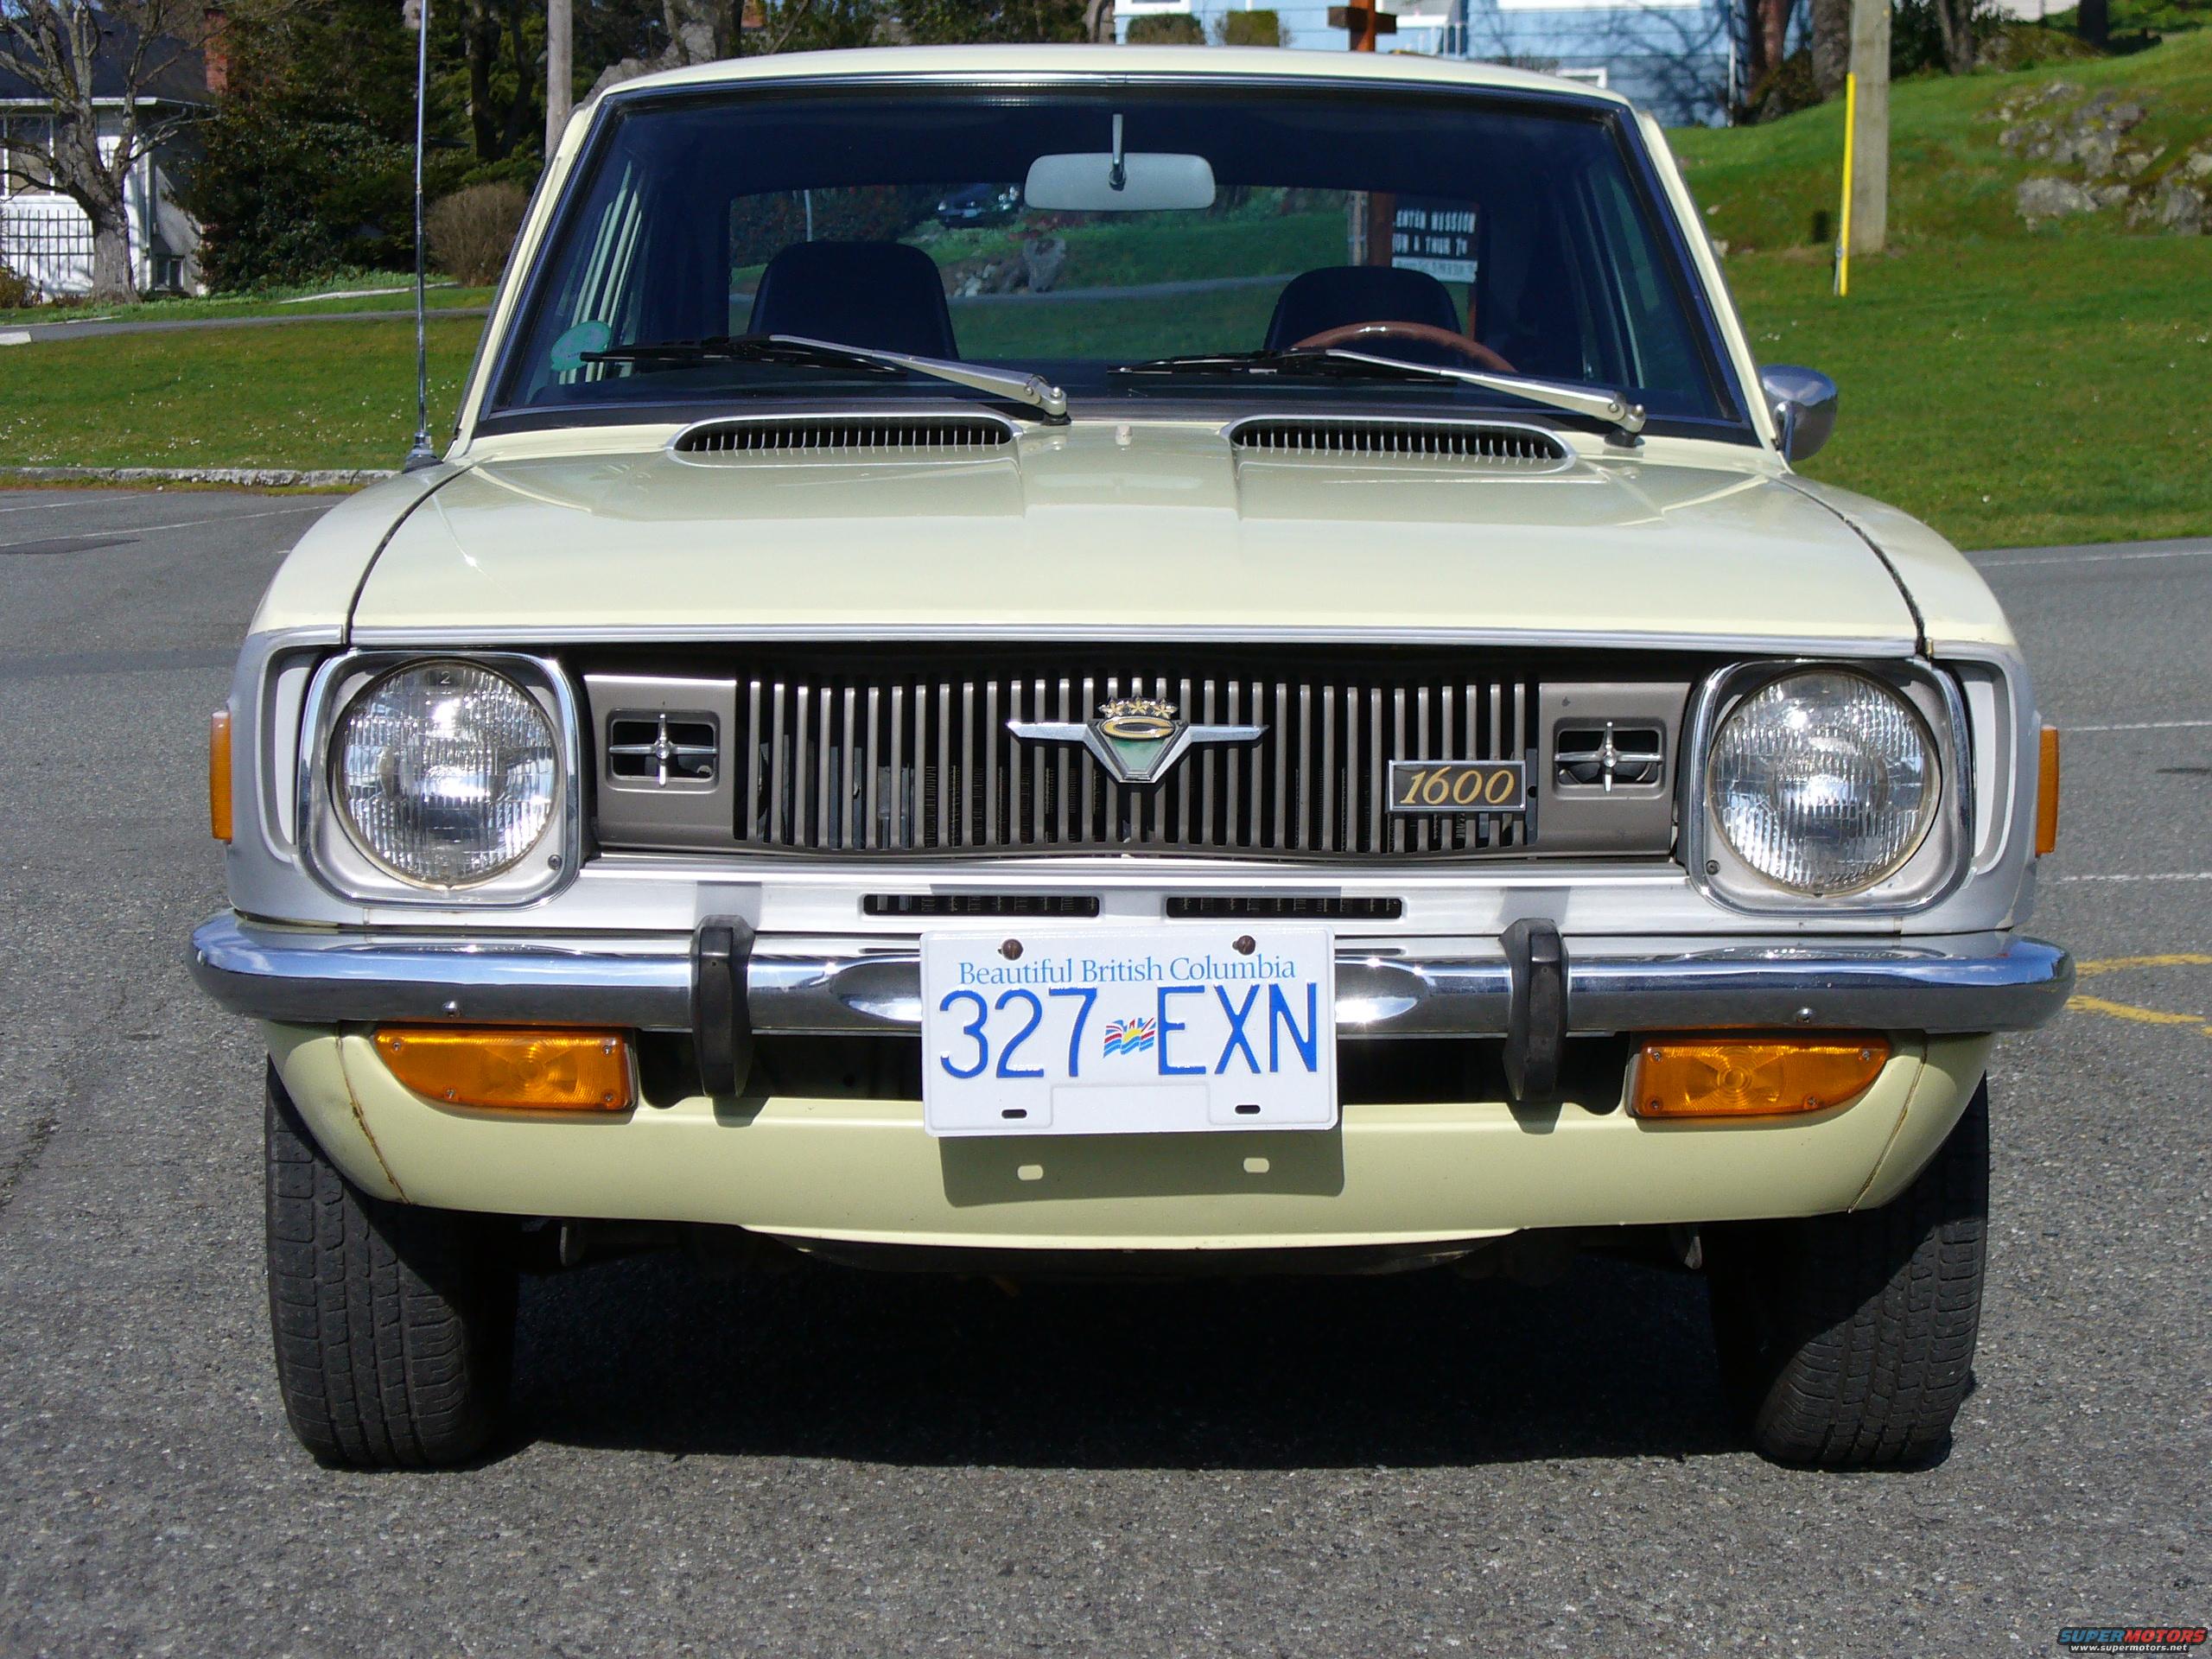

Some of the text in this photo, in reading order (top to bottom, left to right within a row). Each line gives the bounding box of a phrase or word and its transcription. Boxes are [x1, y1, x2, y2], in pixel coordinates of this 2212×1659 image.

[441, 671, 450, 683] 2
[1400, 766, 1515, 804] 1600
[958, 953, 1295, 985] Beautiful British Columbia
[939, 982, 1318, 1079] 327 EXN
